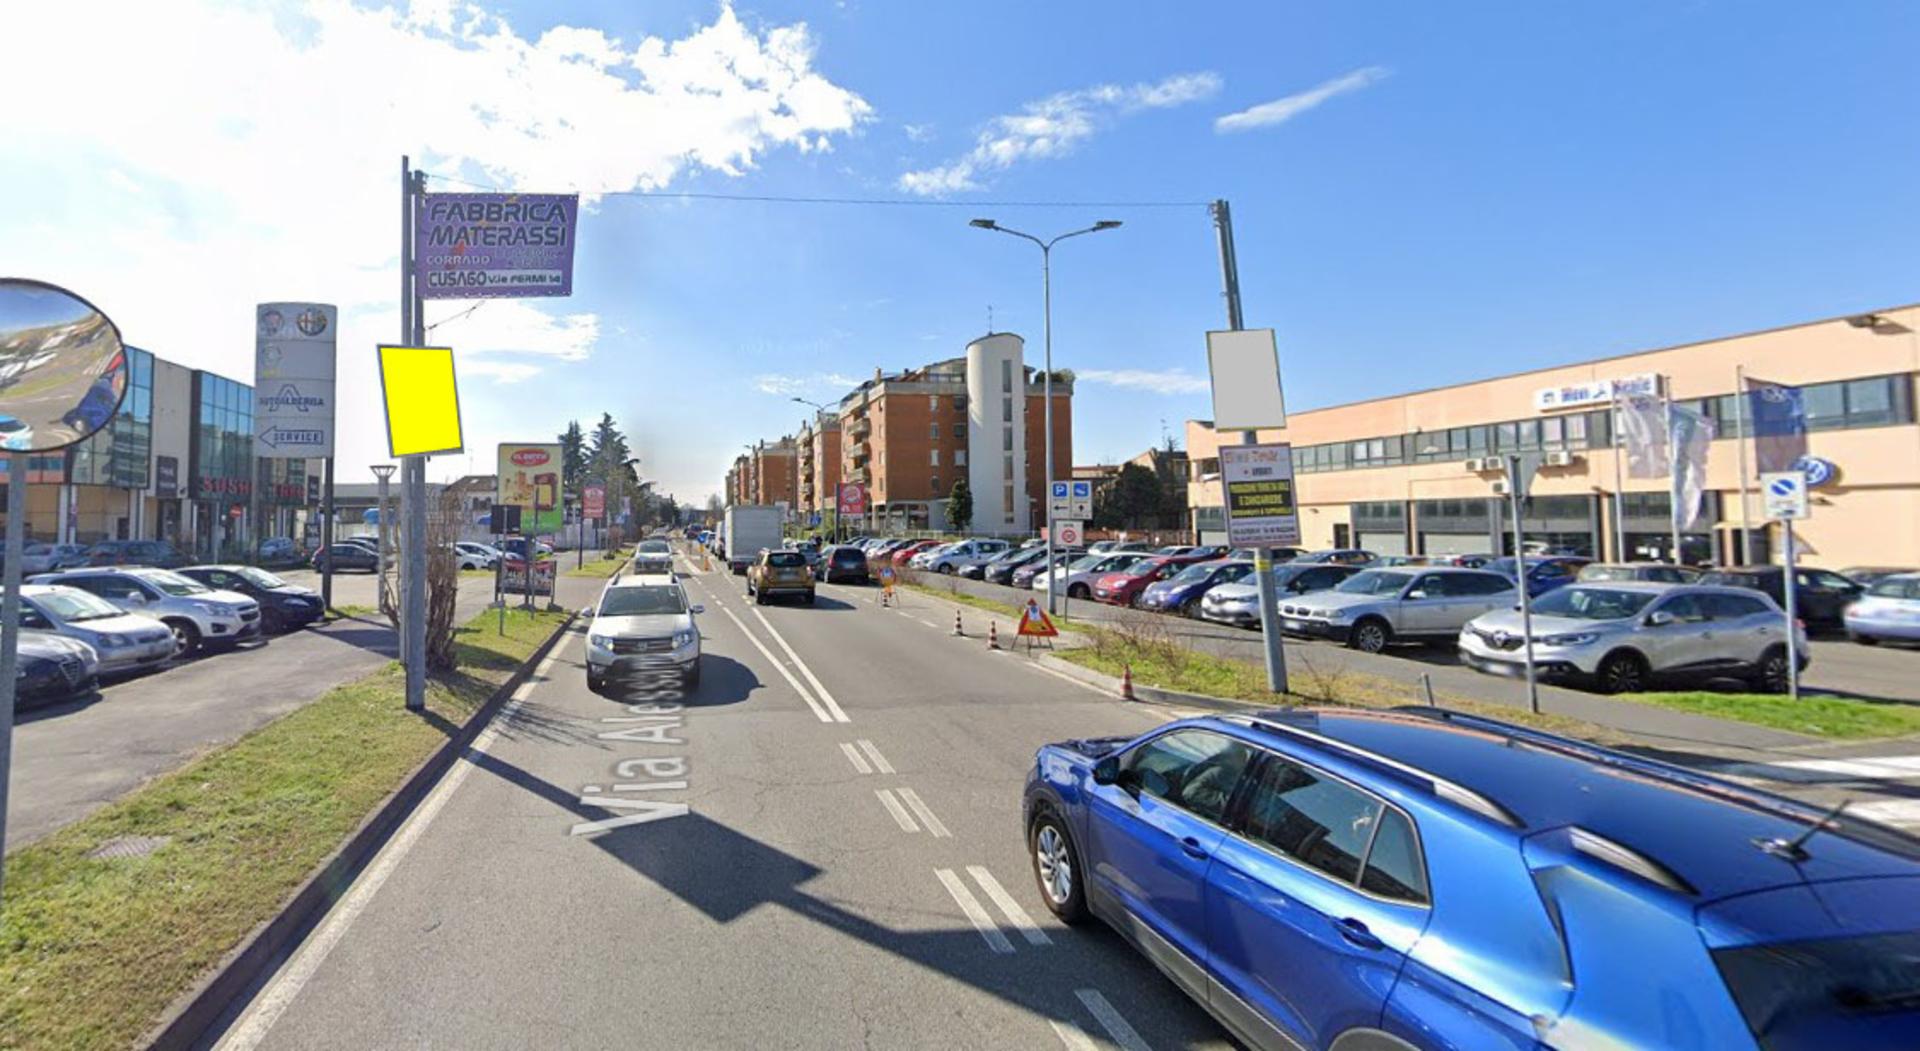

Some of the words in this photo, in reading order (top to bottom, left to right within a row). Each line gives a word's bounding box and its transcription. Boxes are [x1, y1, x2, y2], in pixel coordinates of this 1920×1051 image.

[430, 202, 567, 222] FABBRICA
[428, 225, 567, 246] MATERASSI
[426, 255, 491, 265] CORRADO
[429, 271, 487, 287] CUSAGO
[274, 433, 319, 441] SERVICE
